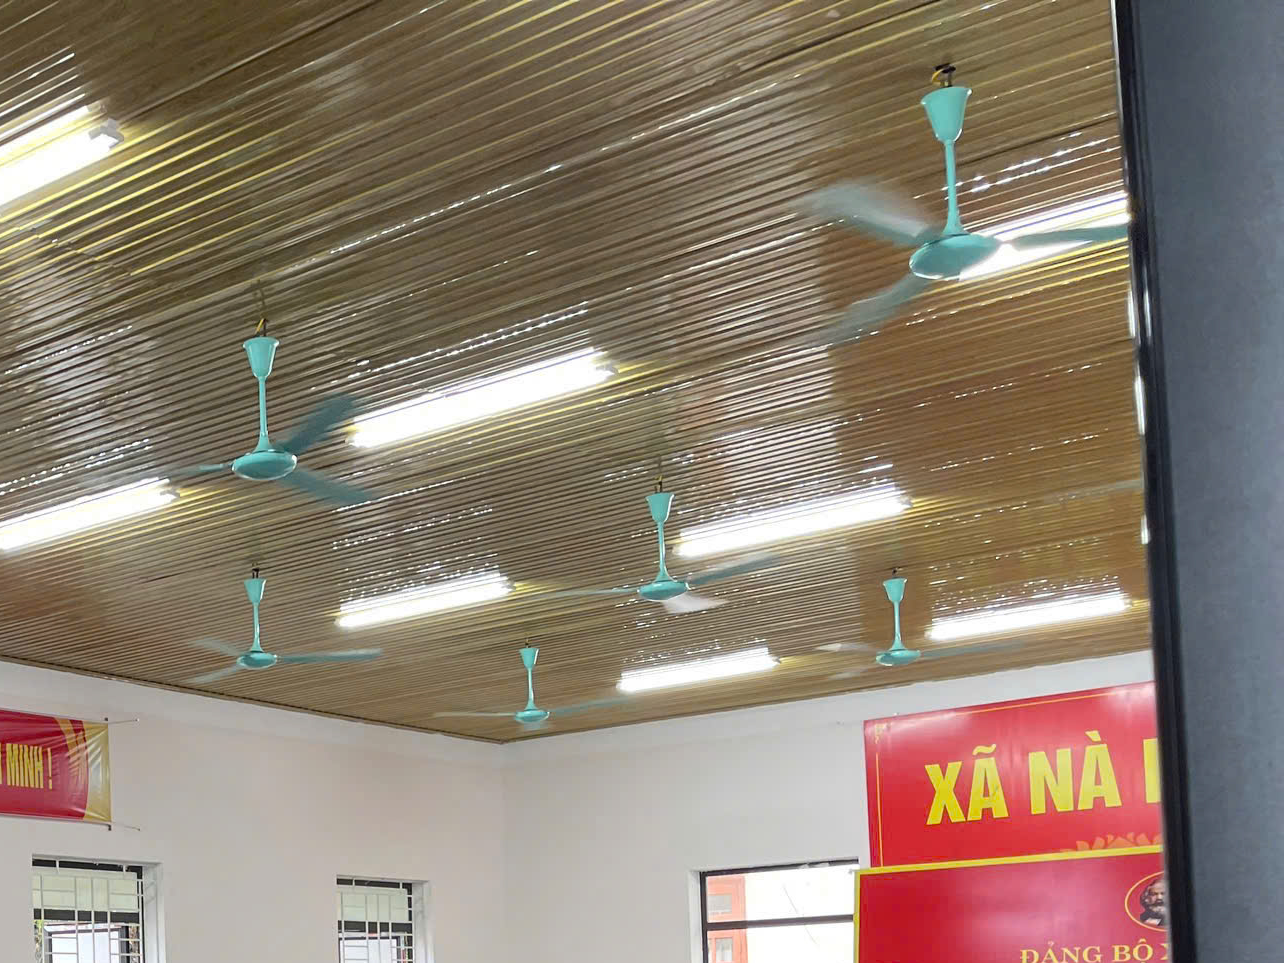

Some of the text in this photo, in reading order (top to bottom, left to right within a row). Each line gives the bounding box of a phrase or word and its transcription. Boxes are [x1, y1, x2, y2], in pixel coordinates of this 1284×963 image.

[6, 743, 44, 789] MINH
[924, 743, 1009, 825] XÃ
[1028, 730, 1122, 815] NÀ
